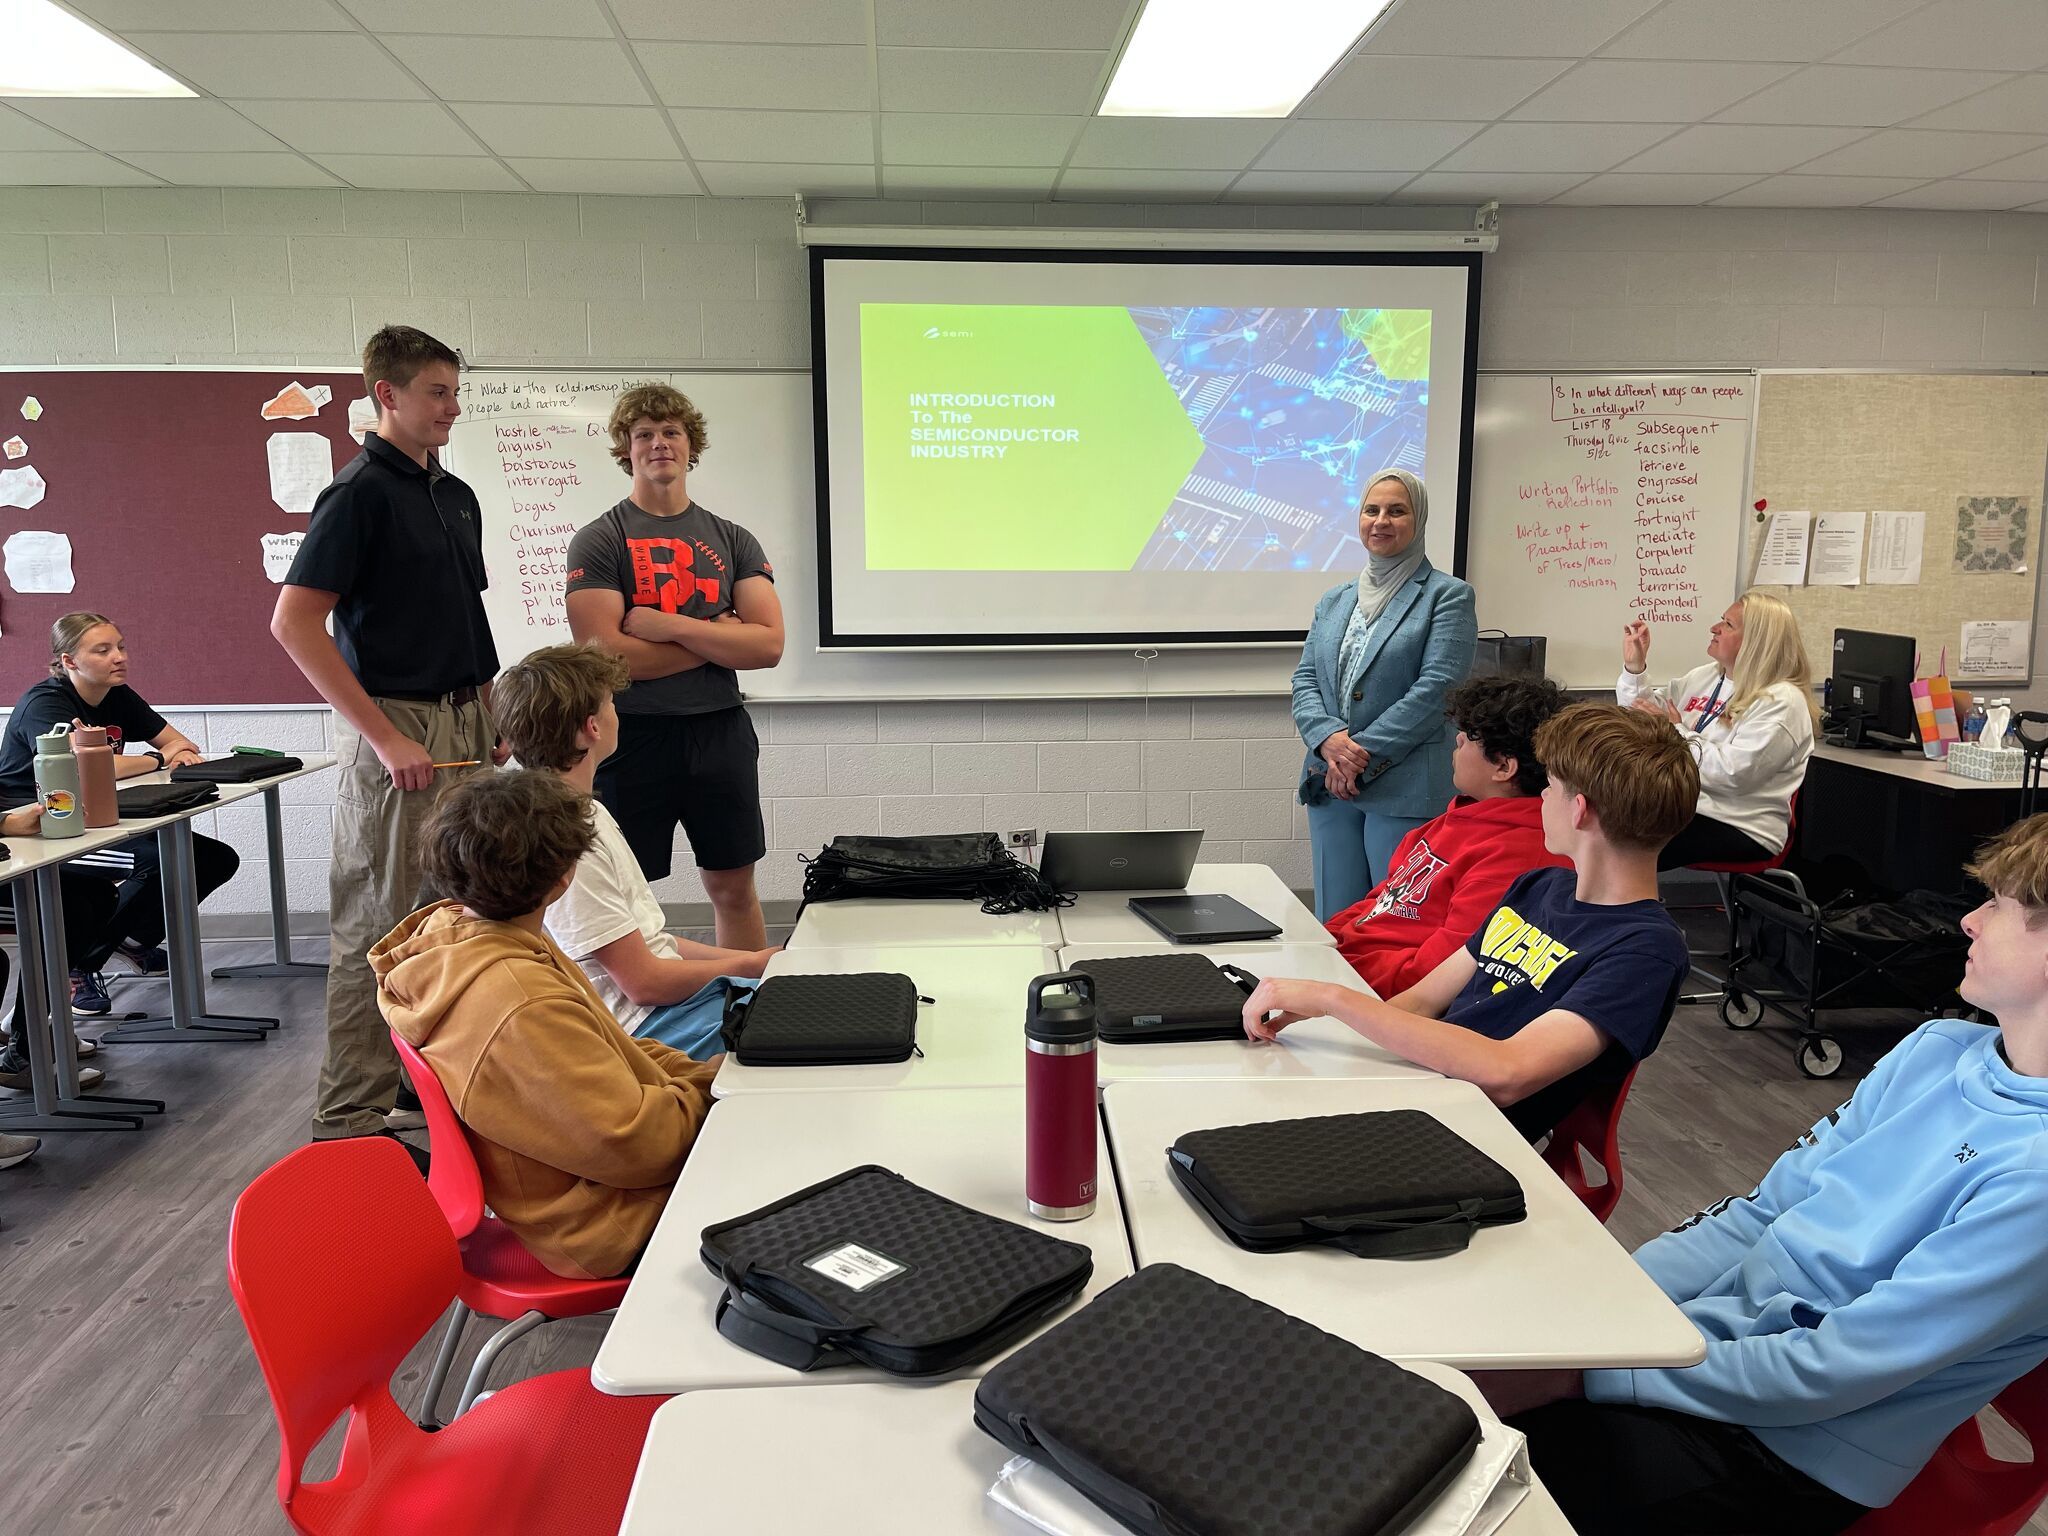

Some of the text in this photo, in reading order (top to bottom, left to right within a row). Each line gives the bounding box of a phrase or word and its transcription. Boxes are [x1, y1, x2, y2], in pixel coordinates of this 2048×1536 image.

[942, 330, 974, 338] semi
[460, 382, 473, 400] 7
[480, 382, 509, 397] What
[513, 384, 521, 394] is
[523, 380, 547, 395] the
[555, 380, 619, 399] relationship
[1555, 382, 1744, 406] 8 In what different ways can people
[466, 396, 577, 421] people and nature?
[909, 393, 1056, 408] INTRODUCTION
[910, 410, 973, 424] To The
[1572, 400, 1645, 420] be intelligent?
[495, 424, 541, 438] hostile
[1602, 418, 1612, 430] 18
[910, 428, 1080, 443] SEMICONDUCTOR
[1564, 435, 1605, 450] Thursday
[911, 445, 1009, 459] INDUSTRY
[502, 456, 577, 473] boisterous
[505, 473, 582, 497] interrogate
[1519, 481, 1569, 500] Writing
[1637, 472, 1698, 494] engrossed
[511, 496, 557, 521] bogus
[1633, 507, 1700, 530] fortnight
[1636, 527, 1697, 545] mediate
[516, 538, 568, 564] dilapid
[518, 562, 568, 575] ecsta
[635, 545, 651, 596] WHO WE
[1639, 563, 1687, 577] bravado
[1637, 577, 1699, 592] terrorism
[1629, 595, 1702, 613] despondent
[1637, 609, 1693, 623] albatross
